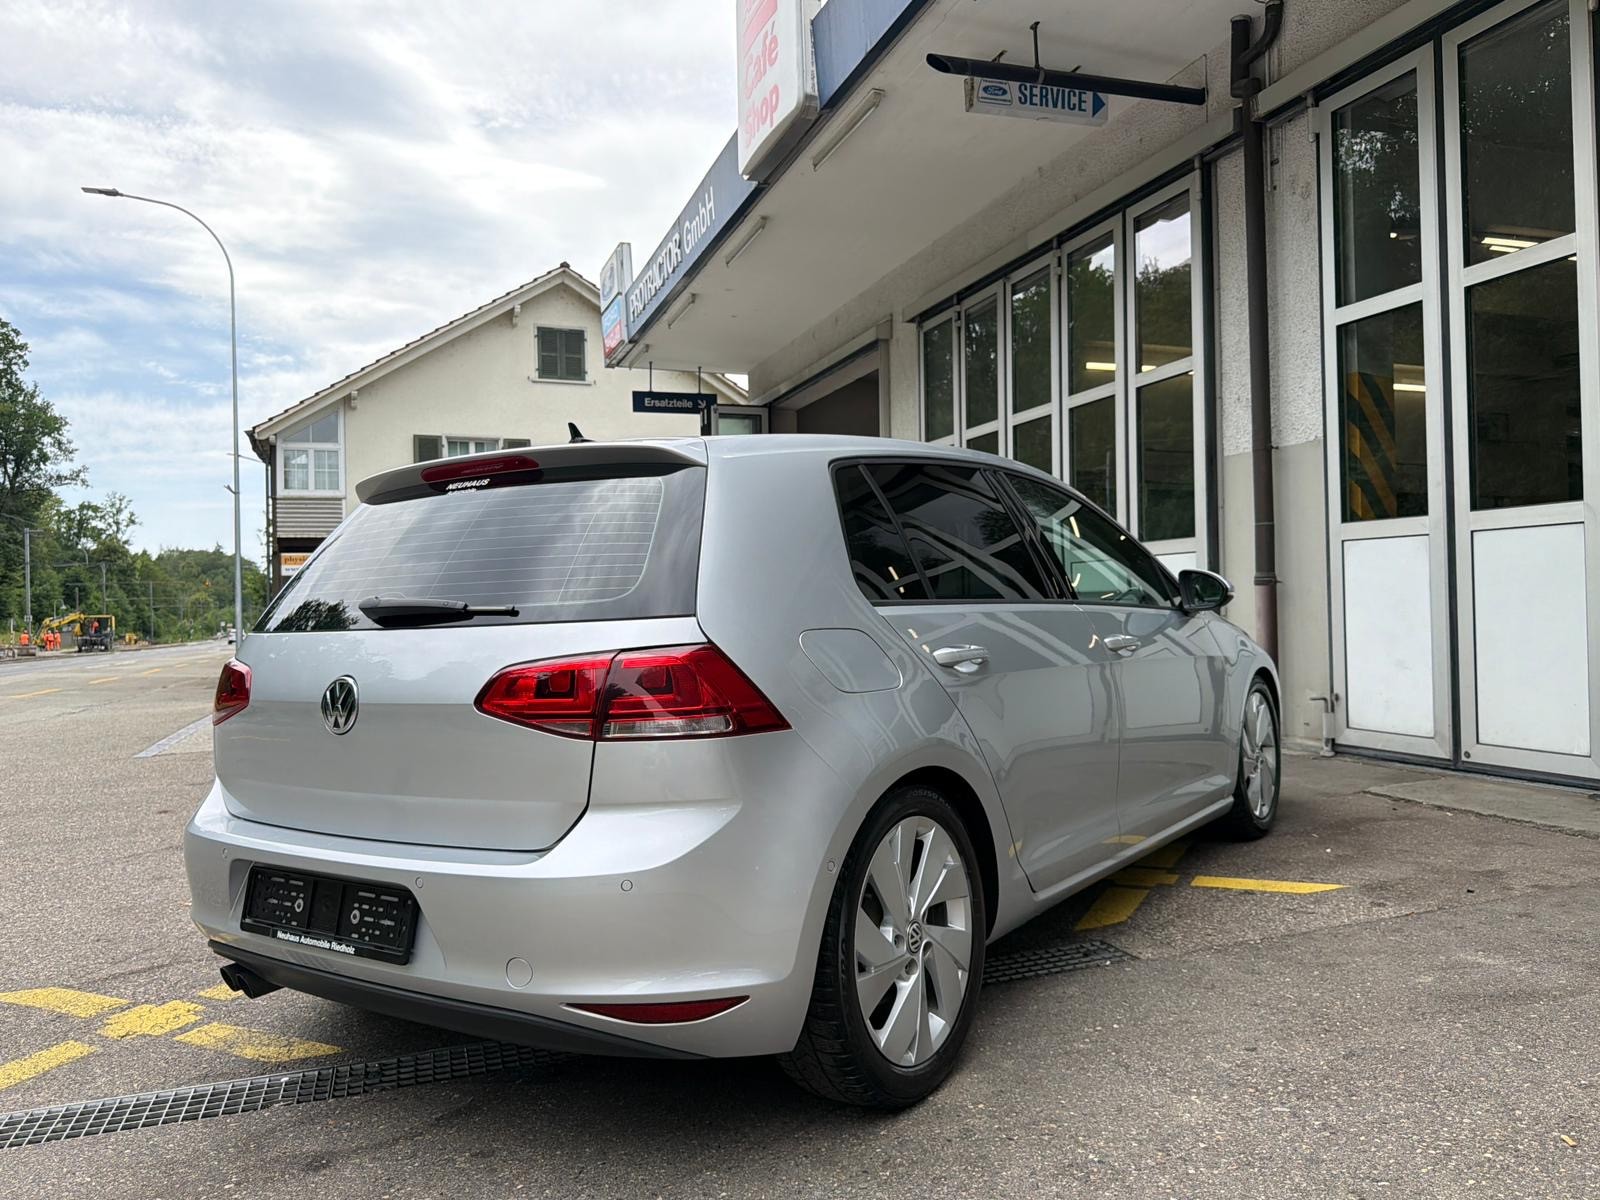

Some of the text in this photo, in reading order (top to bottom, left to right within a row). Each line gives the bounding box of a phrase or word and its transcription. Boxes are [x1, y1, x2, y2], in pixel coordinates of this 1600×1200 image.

[985, 86, 1004, 96] Ford
[1018, 83, 1087, 112] SERVICE
[629, 186, 716, 323] PROTRACTOR GmbH
[644, 397, 693, 408] Ersatzteile
[446, 479, 490, 490] NEUHAUS
[277, 930, 356, 955] Neuhaus Automobile Riedholz
